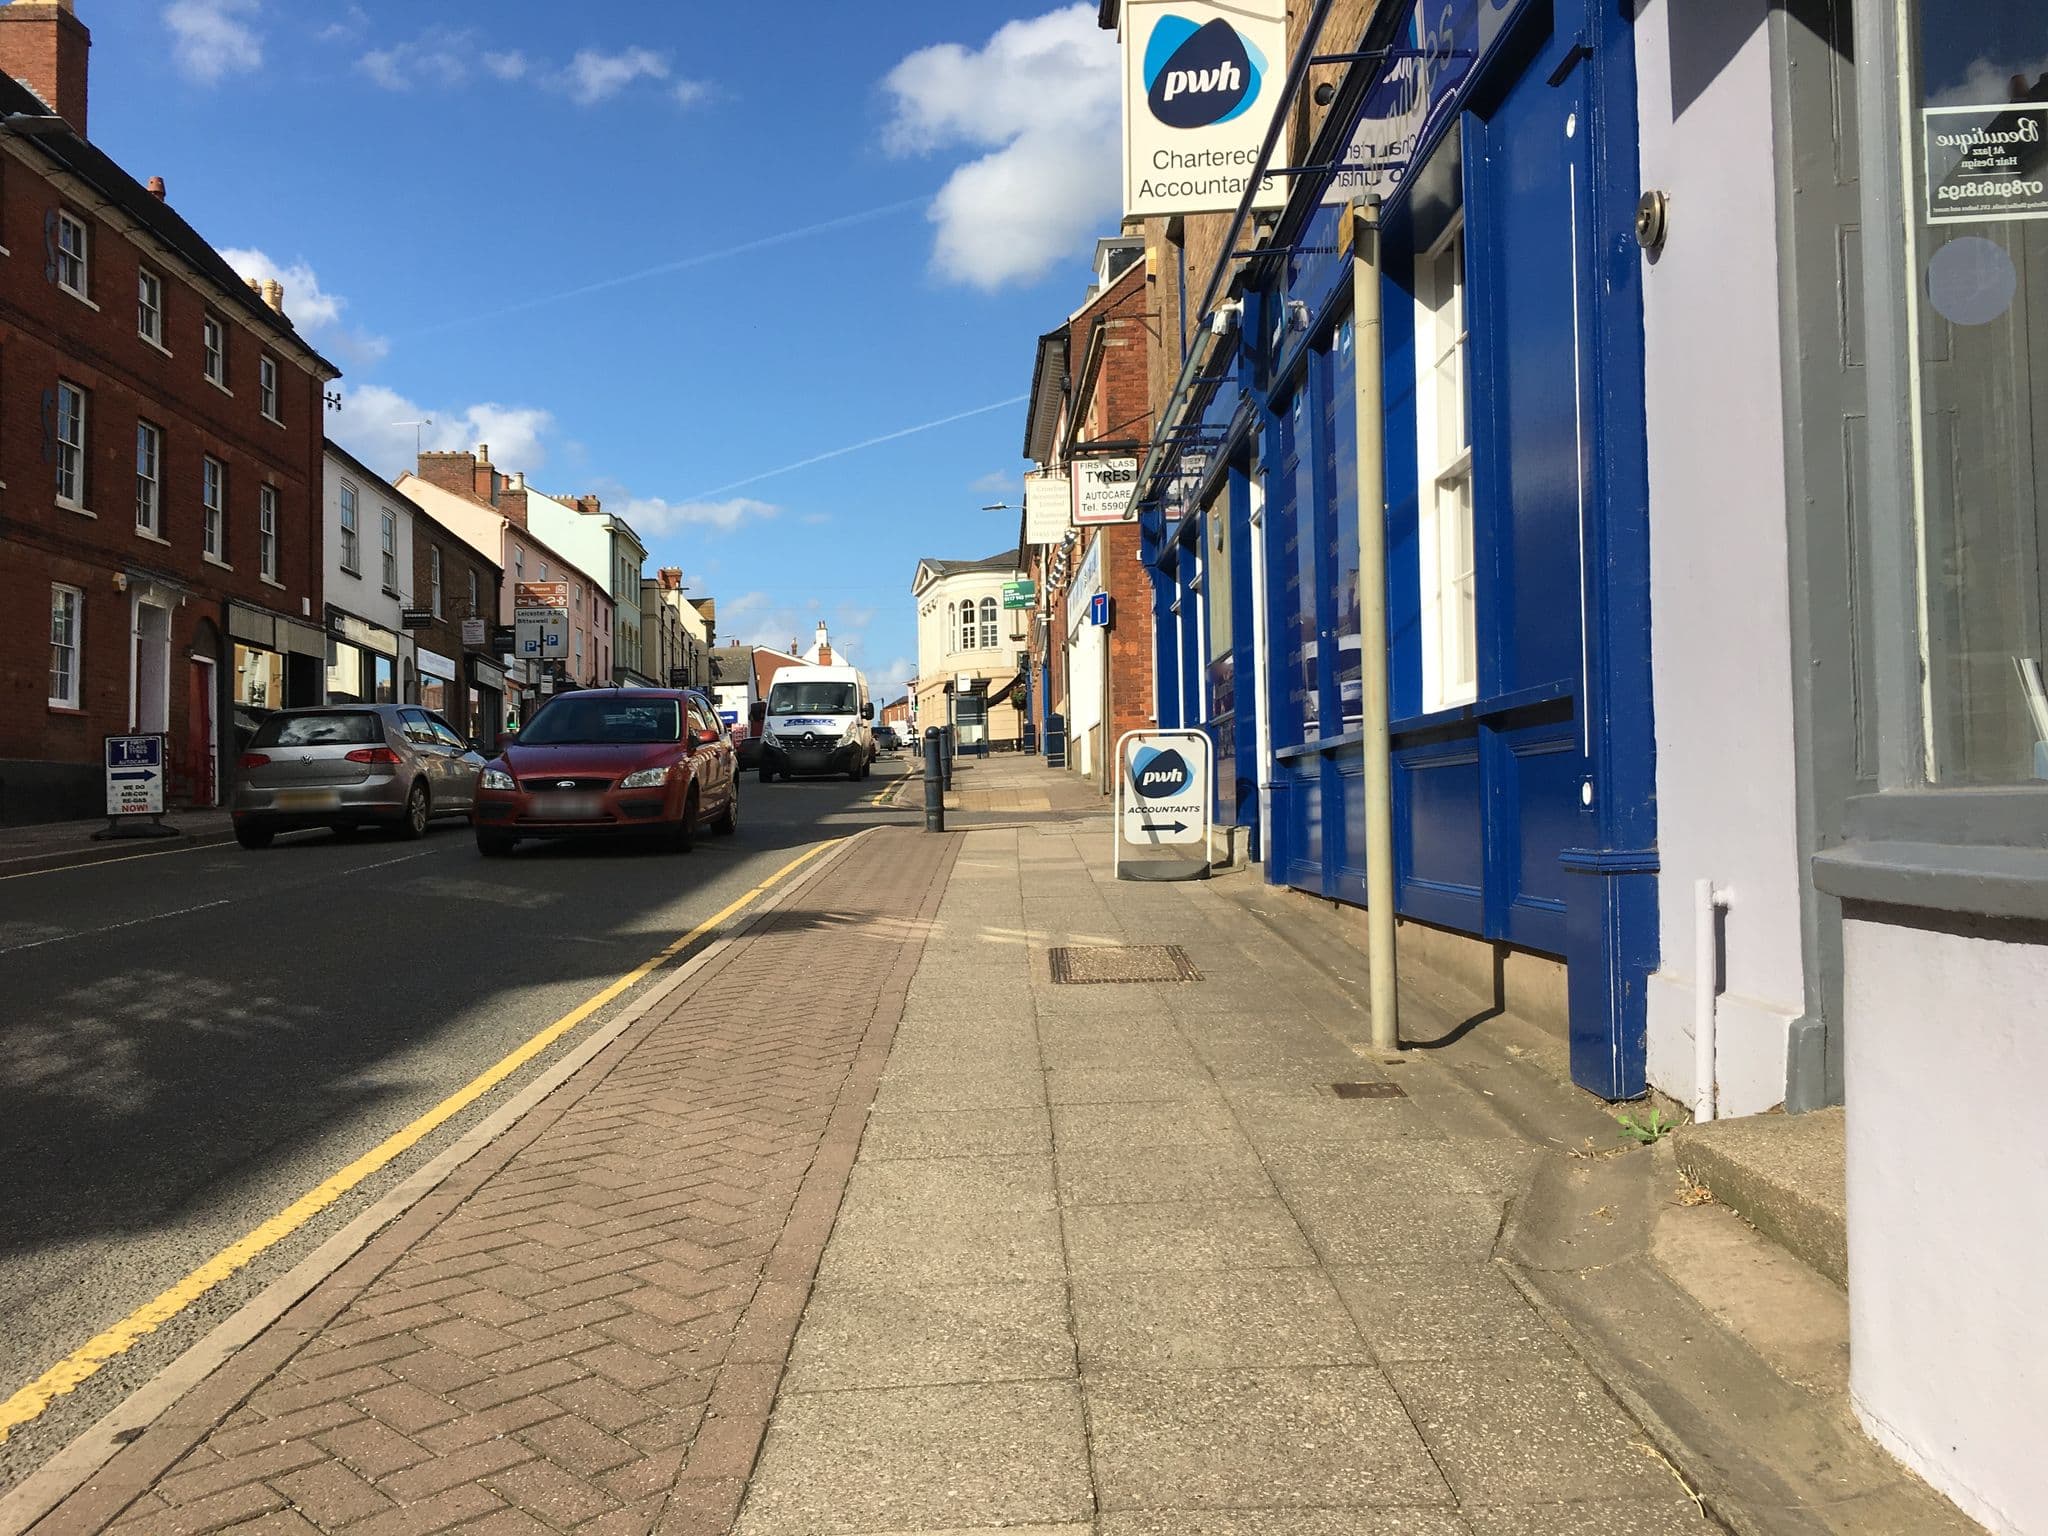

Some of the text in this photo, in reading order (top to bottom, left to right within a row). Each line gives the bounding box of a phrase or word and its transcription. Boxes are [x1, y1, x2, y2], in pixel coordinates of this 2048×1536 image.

[1163, 60, 1241, 102] pwh
[1152, 144, 1260, 170] Chartered
[1138, 175, 1274, 198] Accountas
[1085, 470, 1131, 483] TYRES
[1085, 490, 1132, 500] AUTOCARE
[1081, 501, 1130, 512] Tel. 55900
[1142, 768, 1183, 786] pwh
[121, 804, 149, 813] NOW!
[1127, 805, 1201, 814] ACCOUNTANTS
